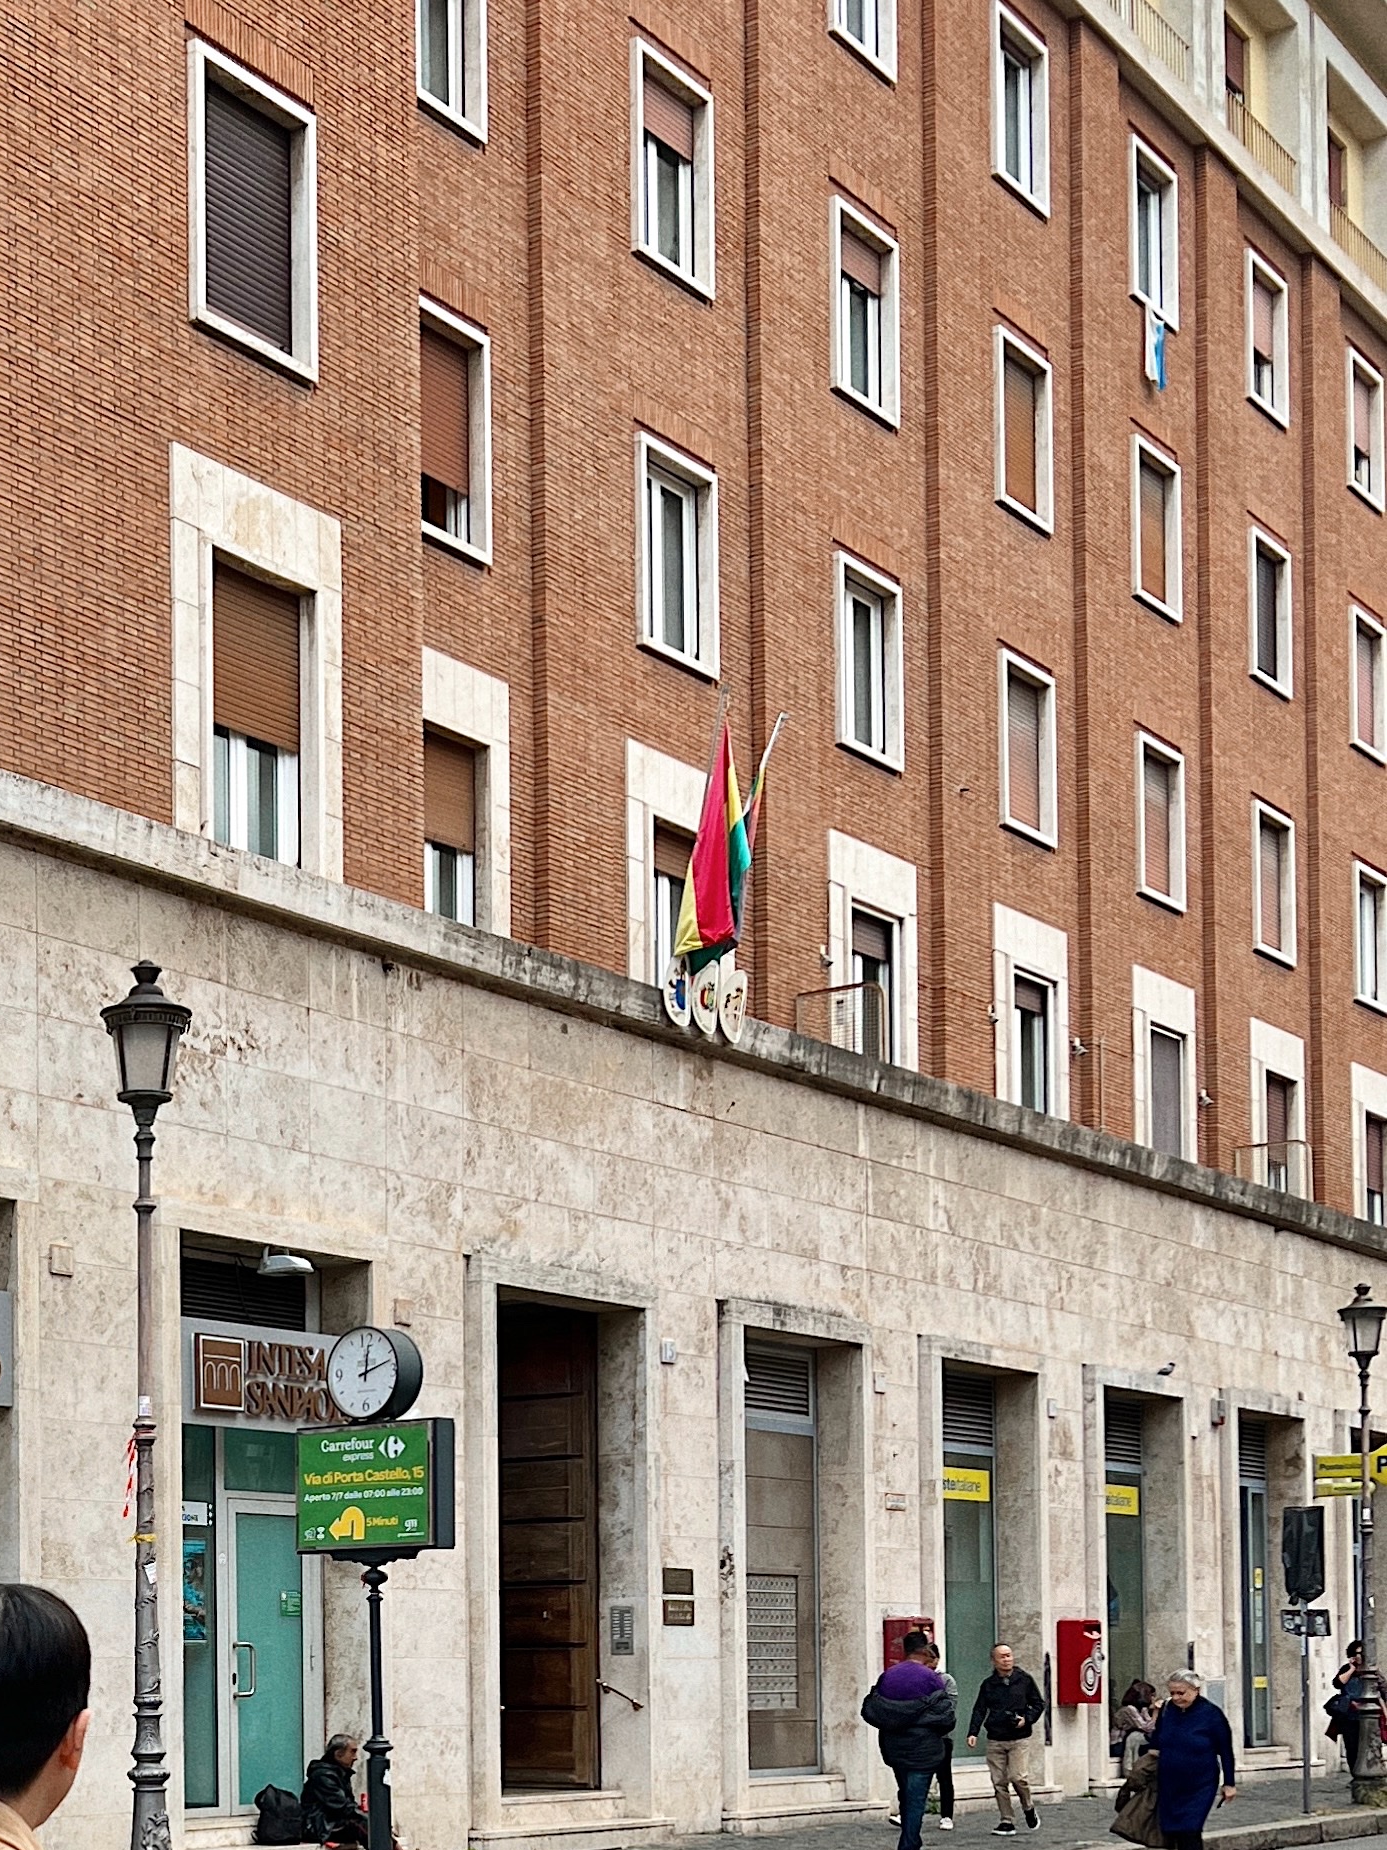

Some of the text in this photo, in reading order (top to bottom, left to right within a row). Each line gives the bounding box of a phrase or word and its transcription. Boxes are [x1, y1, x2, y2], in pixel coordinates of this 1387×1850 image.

[359, 1333, 373, 1348] 12
[246, 1341, 327, 1381] INTESA
[335, 1369, 343, 1382] 9
[246, 1380, 348, 1423] SANPAO
[362, 1397, 370, 1412] 6
[320, 1437, 375, 1453] Carrefour
[342, 1452, 374, 1463] express
[304, 1466, 424, 1485] Via di Porta Castello, 15
[304, 1493, 331, 1503] Aperto
[331, 1492, 344, 1502] 7/7
[344, 1490, 363, 1500] dalle
[386, 1488, 400, 1497] alle
[366, 1515, 399, 1527] 5 Minuti
